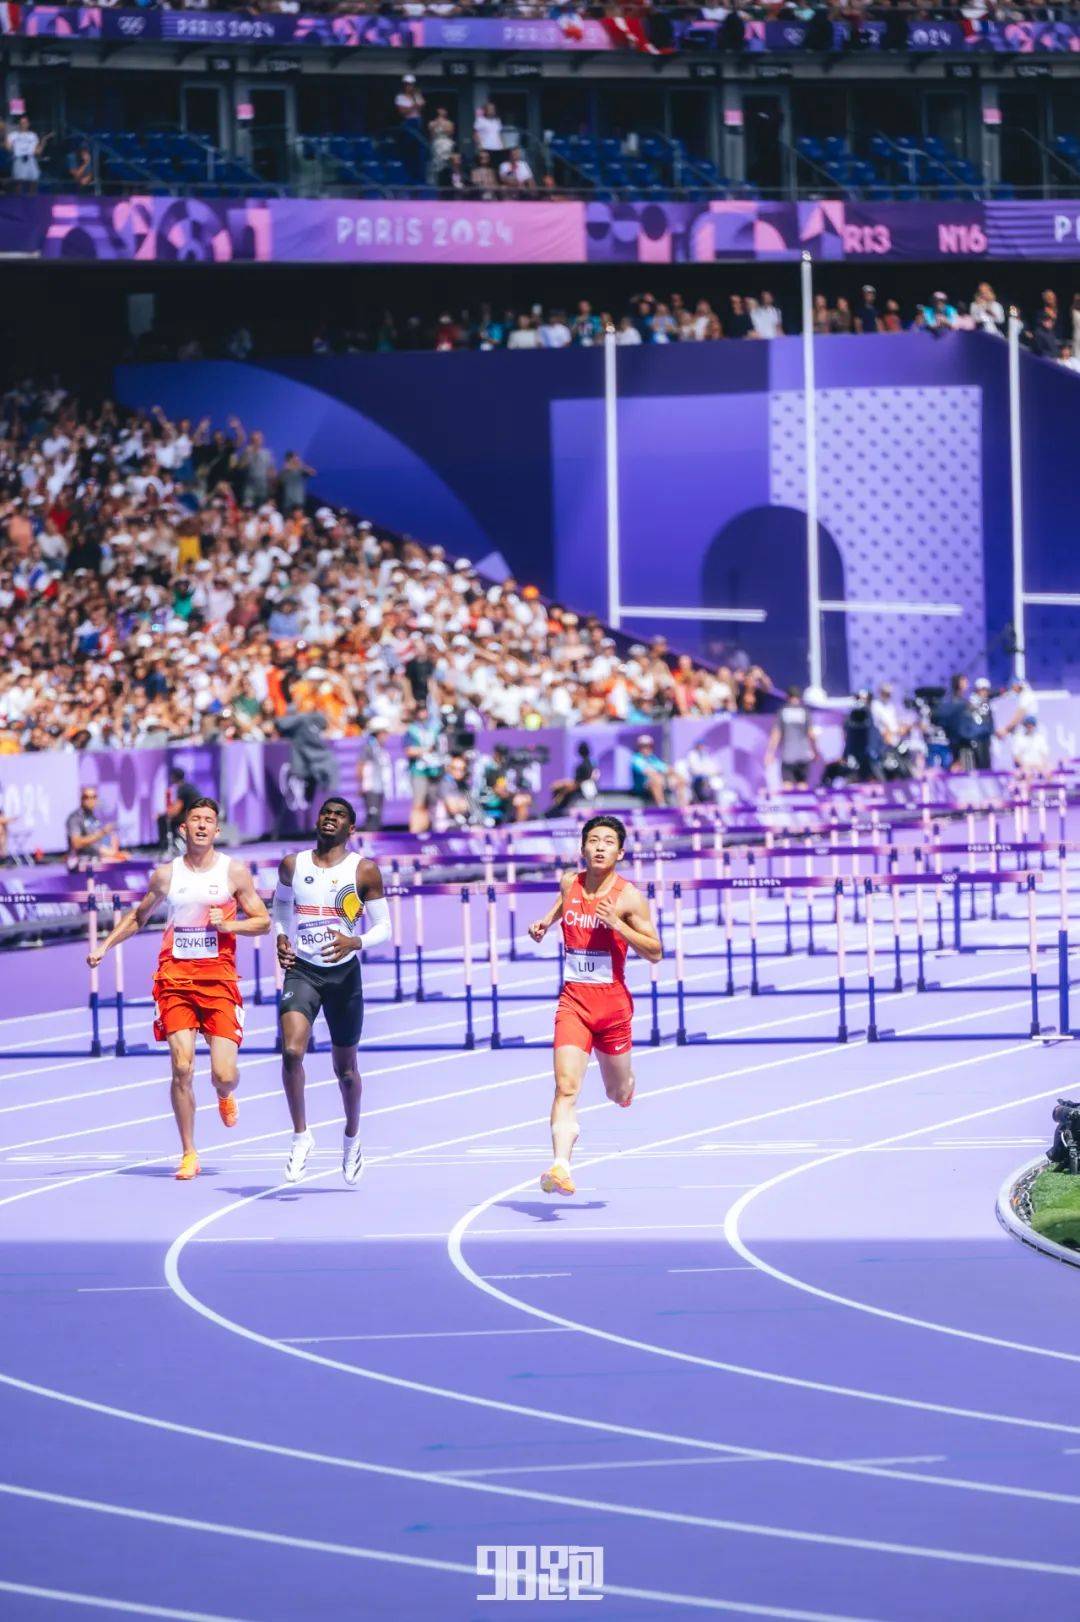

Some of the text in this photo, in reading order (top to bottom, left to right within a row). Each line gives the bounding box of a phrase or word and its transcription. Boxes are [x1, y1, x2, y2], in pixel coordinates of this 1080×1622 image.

[905, 29, 951, 46] 024
[432, 217, 513, 248] 2024
[843, 223, 987, 254] R13 N16
[1055, 214, 1080, 243] P
[578, 961, 595, 973] LIU
